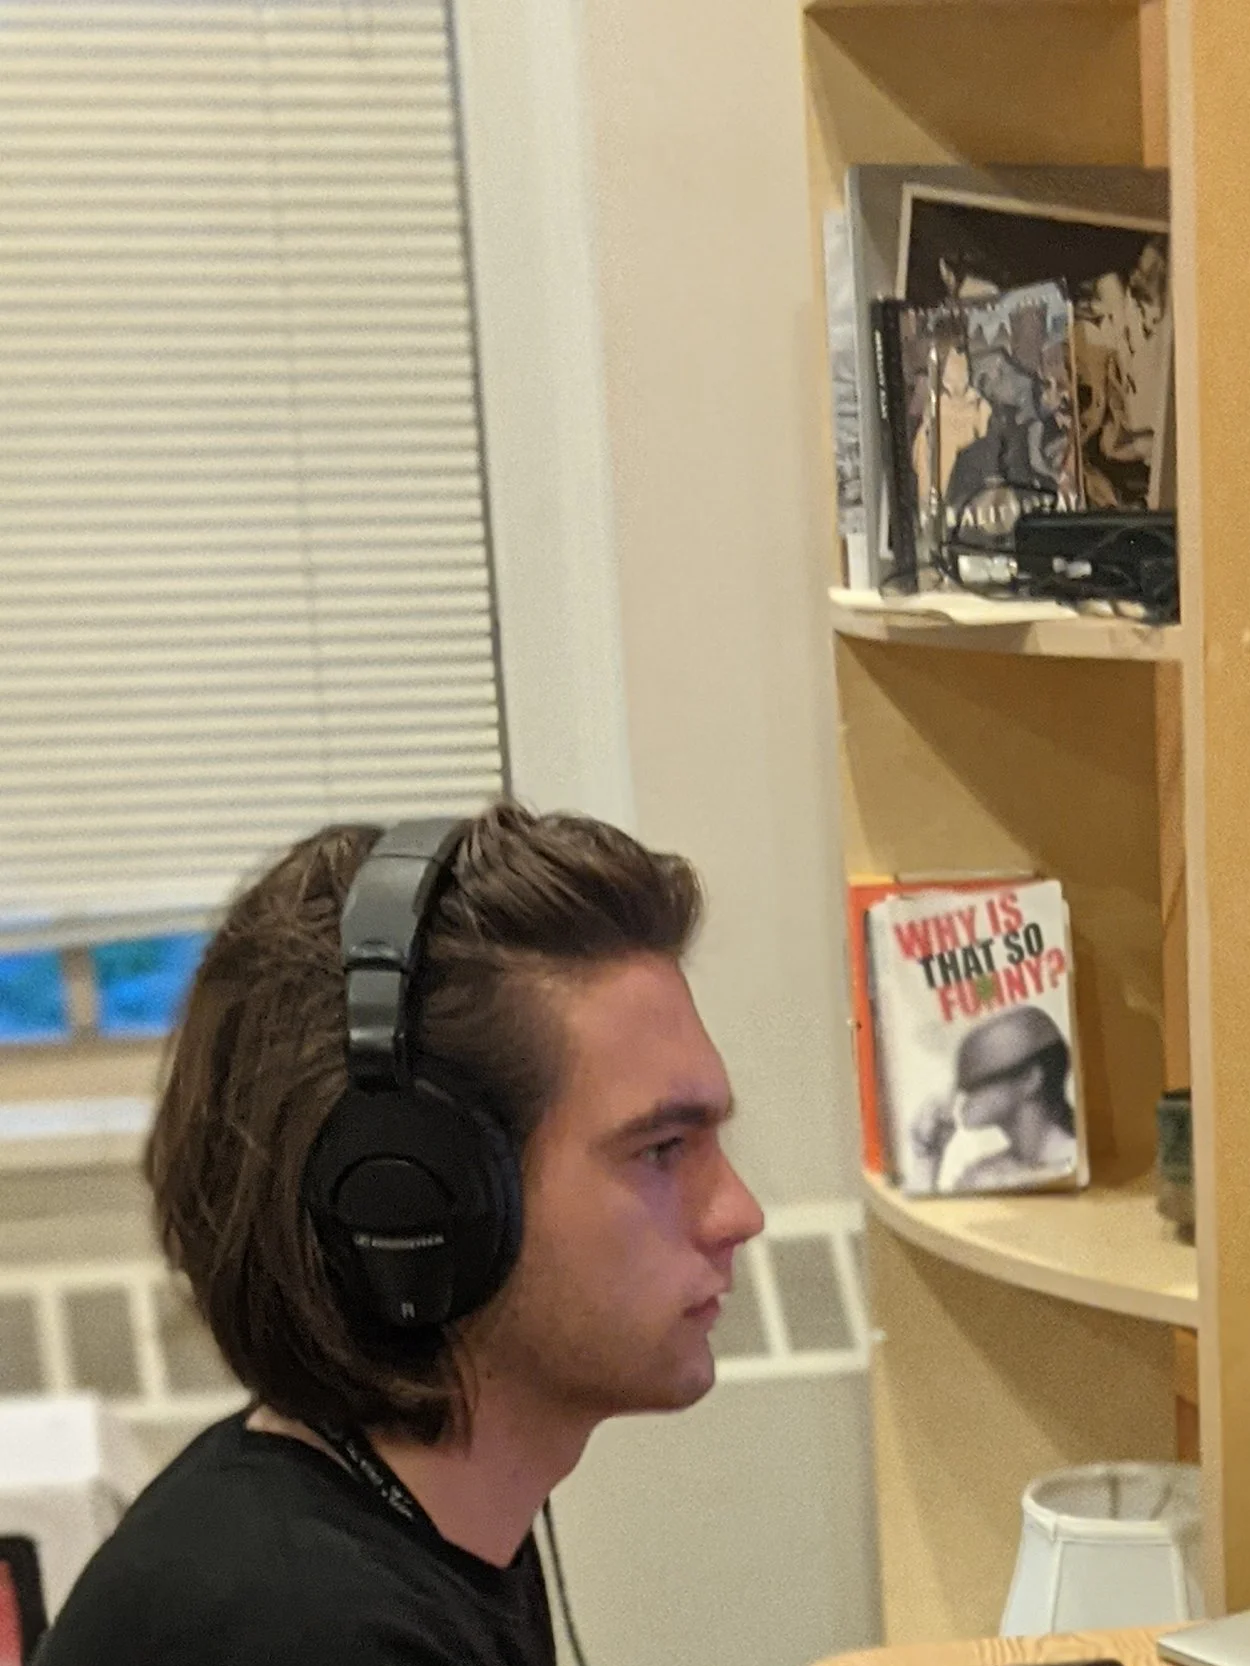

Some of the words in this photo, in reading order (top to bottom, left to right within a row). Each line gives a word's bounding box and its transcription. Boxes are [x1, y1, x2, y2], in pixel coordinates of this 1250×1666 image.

[893, 904, 977, 961] WHY
[986, 892, 1024, 935] IS
[919, 938, 994, 988] THAT
[1003, 922, 1045, 965] SO
